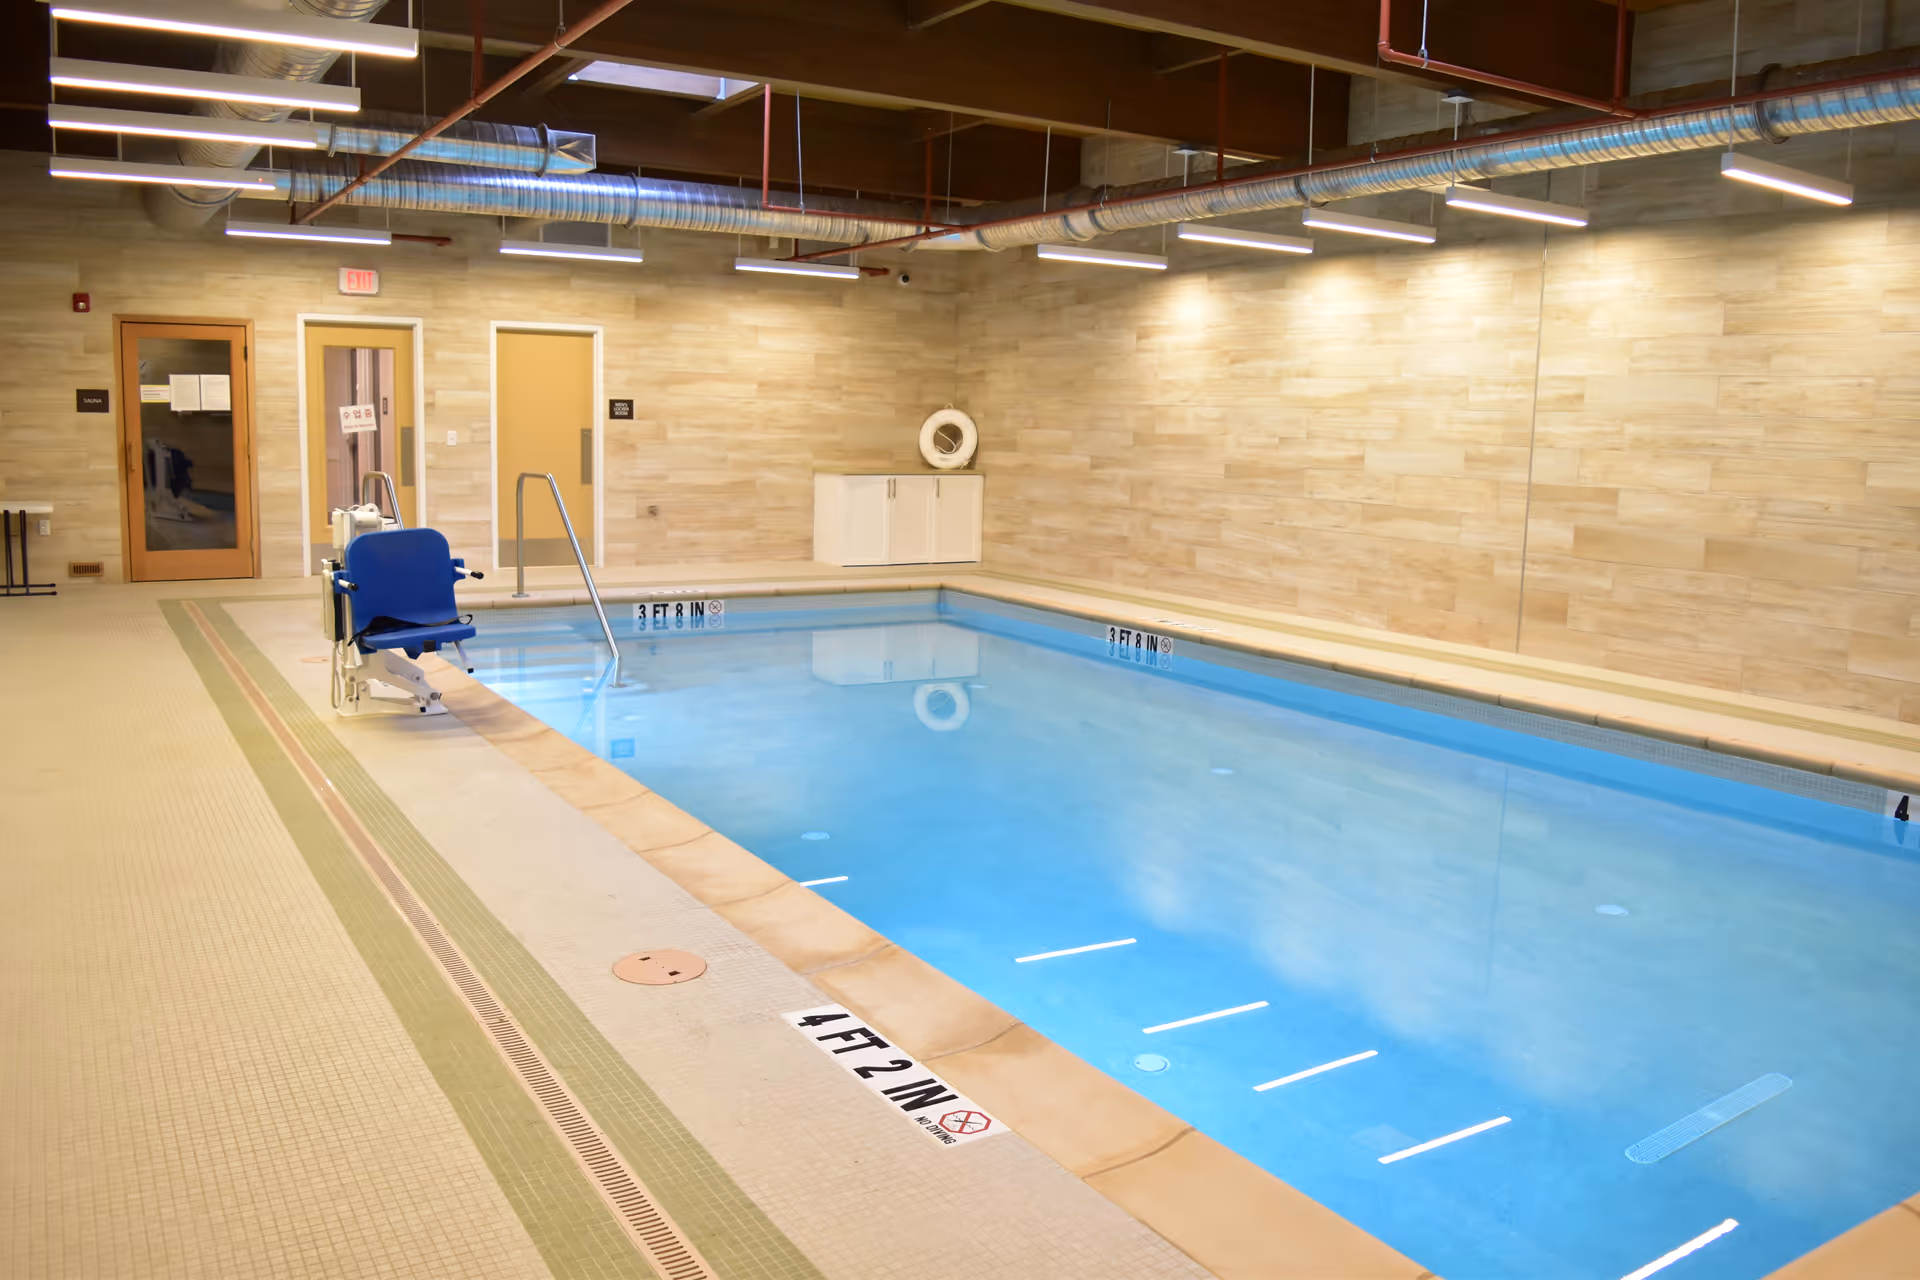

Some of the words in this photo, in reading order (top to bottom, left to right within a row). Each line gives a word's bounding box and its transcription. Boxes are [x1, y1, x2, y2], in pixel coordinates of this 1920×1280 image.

[346, 270, 374, 292] EXIT
[638, 604, 646, 620] 3
[652, 603, 669, 618] FT
[675, 602, 683, 617] 8
[690, 601, 704, 616] IN
[1109, 627, 1116, 643] 3
[1120, 629, 1132, 645] FT
[1135, 633, 1142, 648] 8
[1146, 634, 1158, 652] IN
[1894, 795, 1909, 821] 4
[797, 1013, 850, 1027] 4
[816, 1027, 890, 1055] FT
[853, 1059, 913, 1079] 2
[881, 1078, 959, 1112] IN
[914, 1116, 932, 1126] NO
[925, 1124, 957, 1145] DIVING
